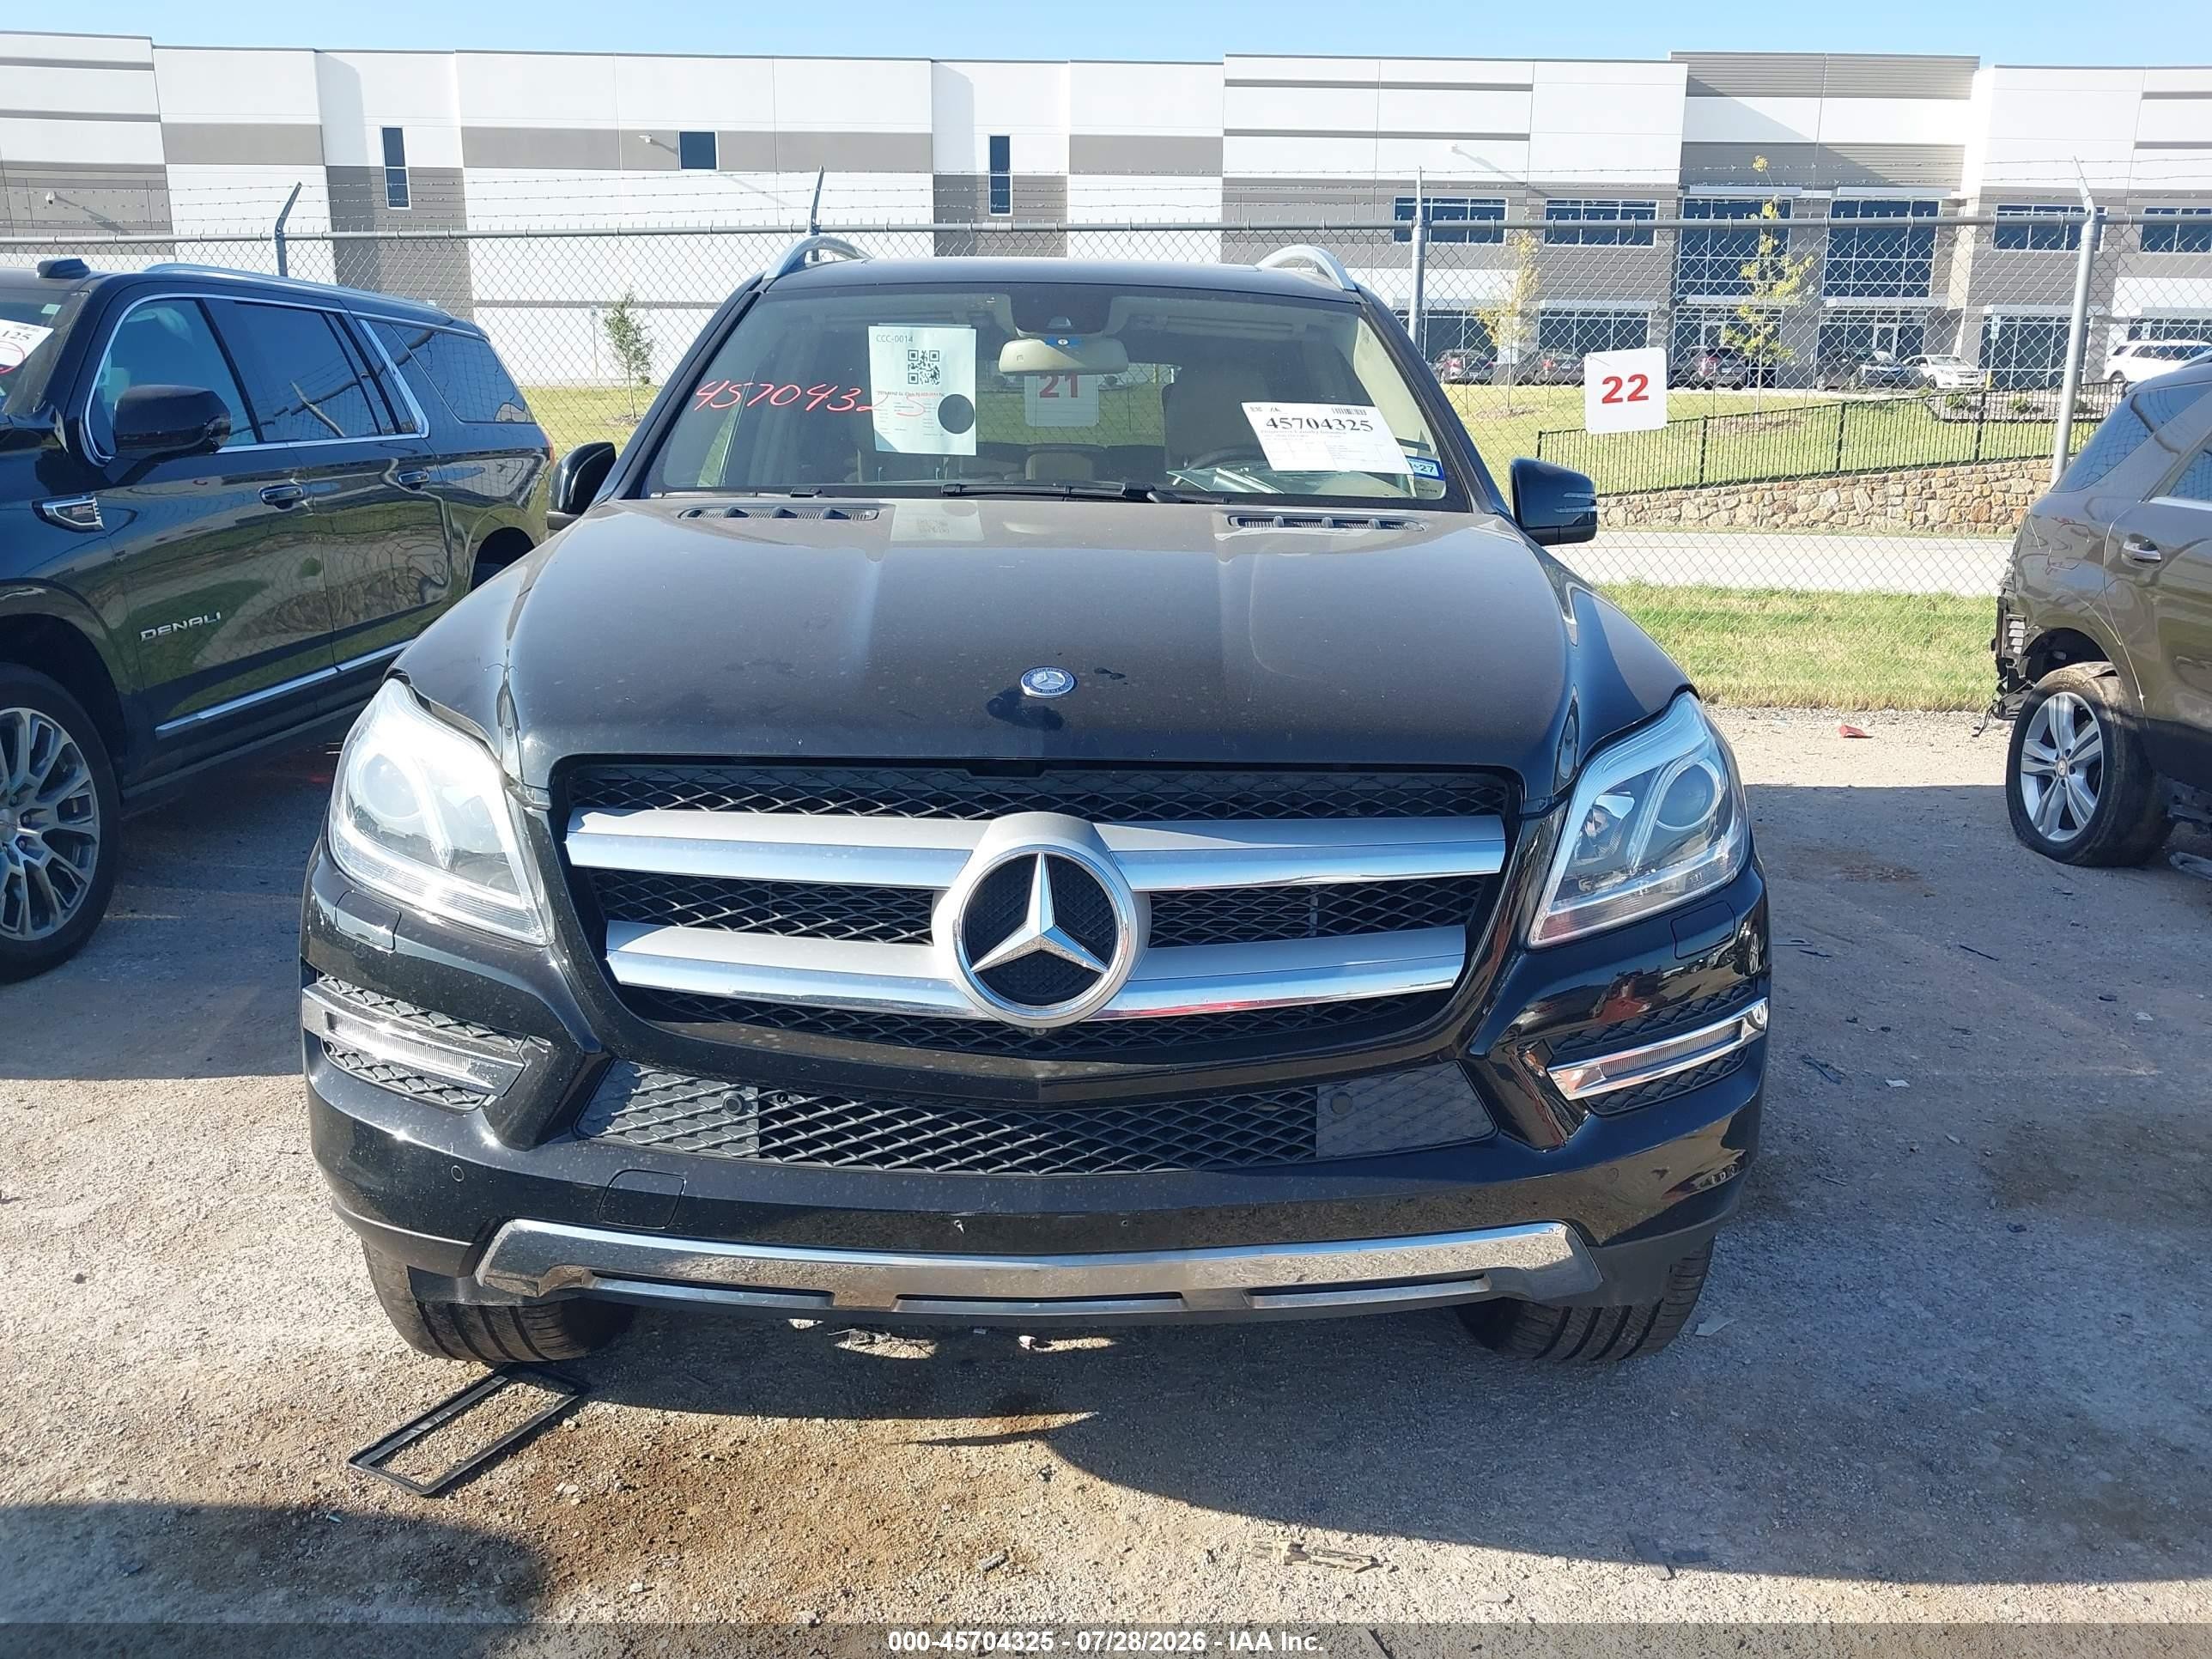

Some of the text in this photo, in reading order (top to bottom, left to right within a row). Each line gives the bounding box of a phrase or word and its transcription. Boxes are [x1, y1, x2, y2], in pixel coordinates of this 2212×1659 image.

[876, 334, 915, 343] CCC-0014
[694, 380, 938, 418] 45704325
[1038, 374, 1079, 398] 21
[1601, 374, 1650, 404] 22
[1266, 416, 1374, 433] 45704325
[140, 611, 222, 642] DENALI
